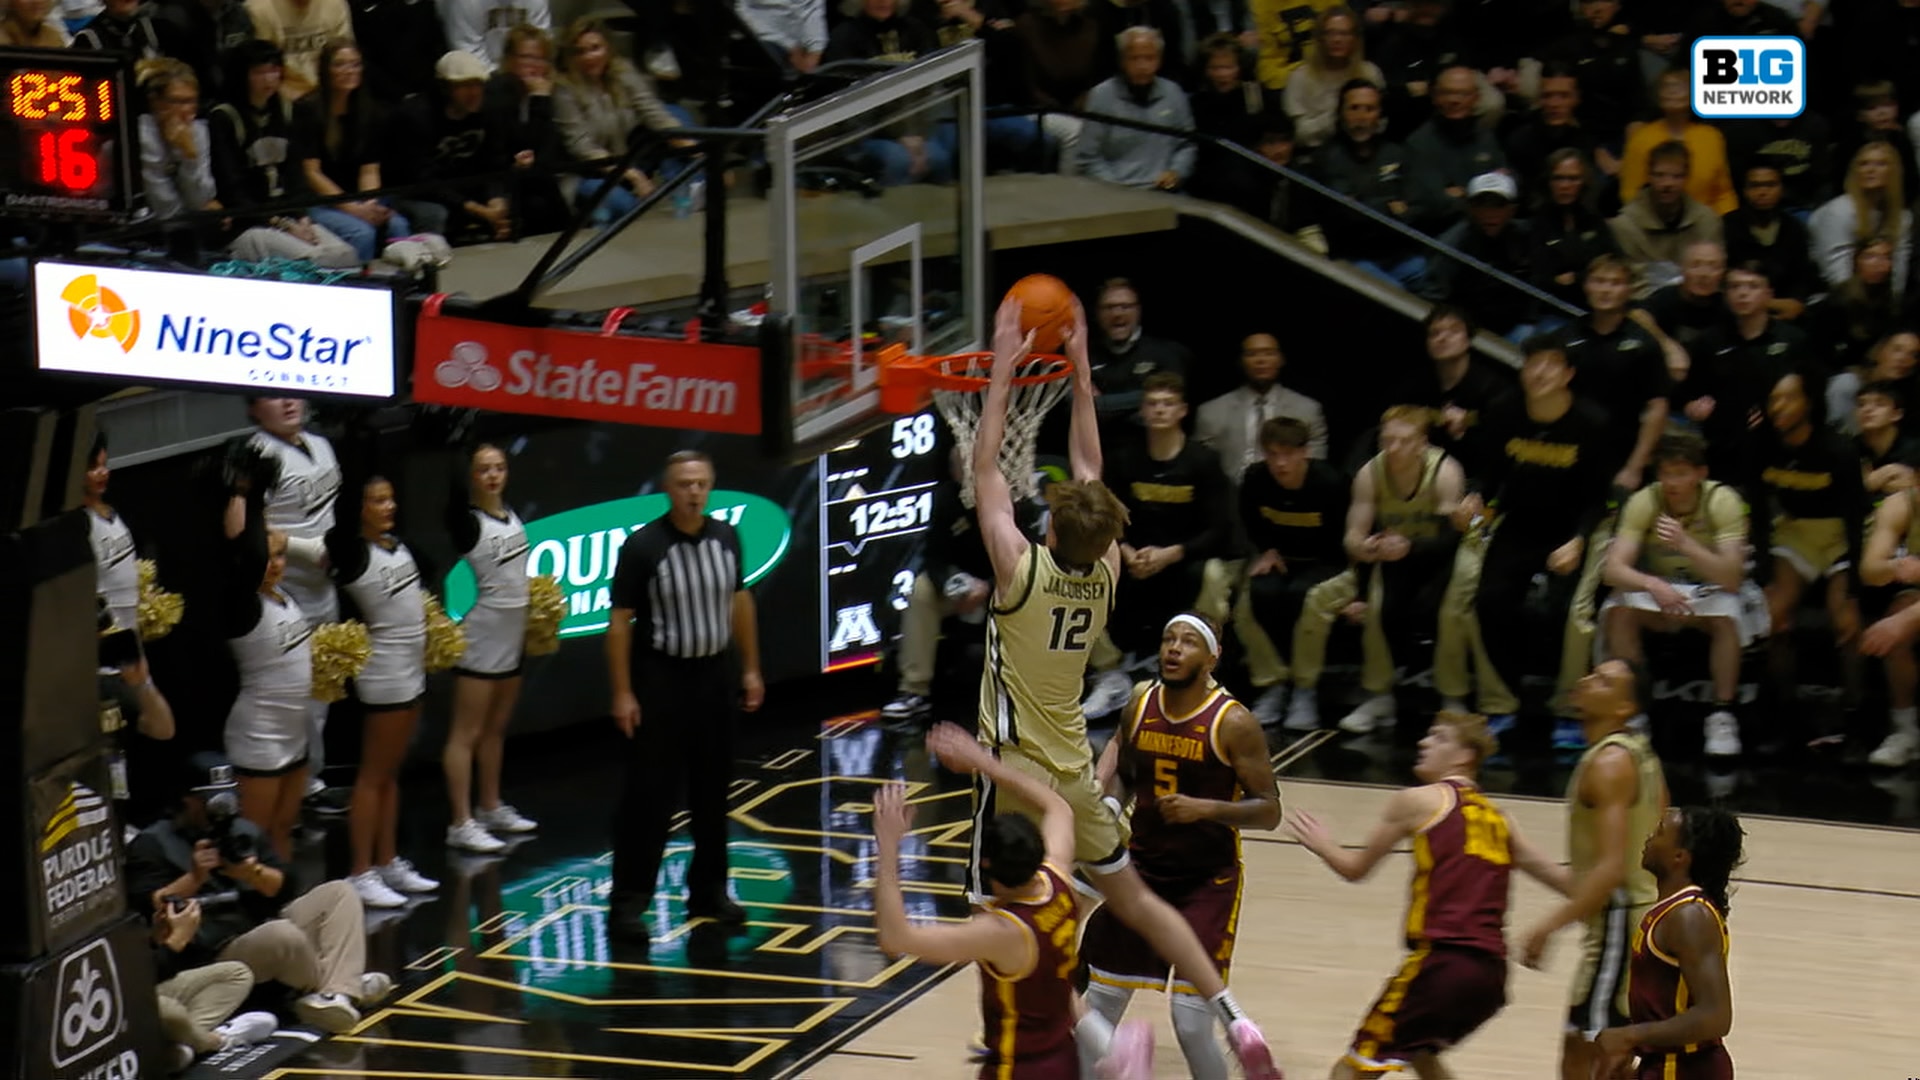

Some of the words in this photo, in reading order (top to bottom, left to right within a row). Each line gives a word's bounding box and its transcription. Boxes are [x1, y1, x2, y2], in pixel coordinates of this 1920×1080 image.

[11, 73, 111, 120] 12:51
[40, 128, 97, 190] 16
[156, 313, 365, 366] NineStar
[891, 412, 936, 460] 58
[850, 491, 932, 536] 12:51
[1047, 605, 1093, 651] 12
[1136, 730, 1204, 762] MINNESOTA
[1153, 758, 1178, 798] 5
[43, 827, 113, 885] PURDUE
